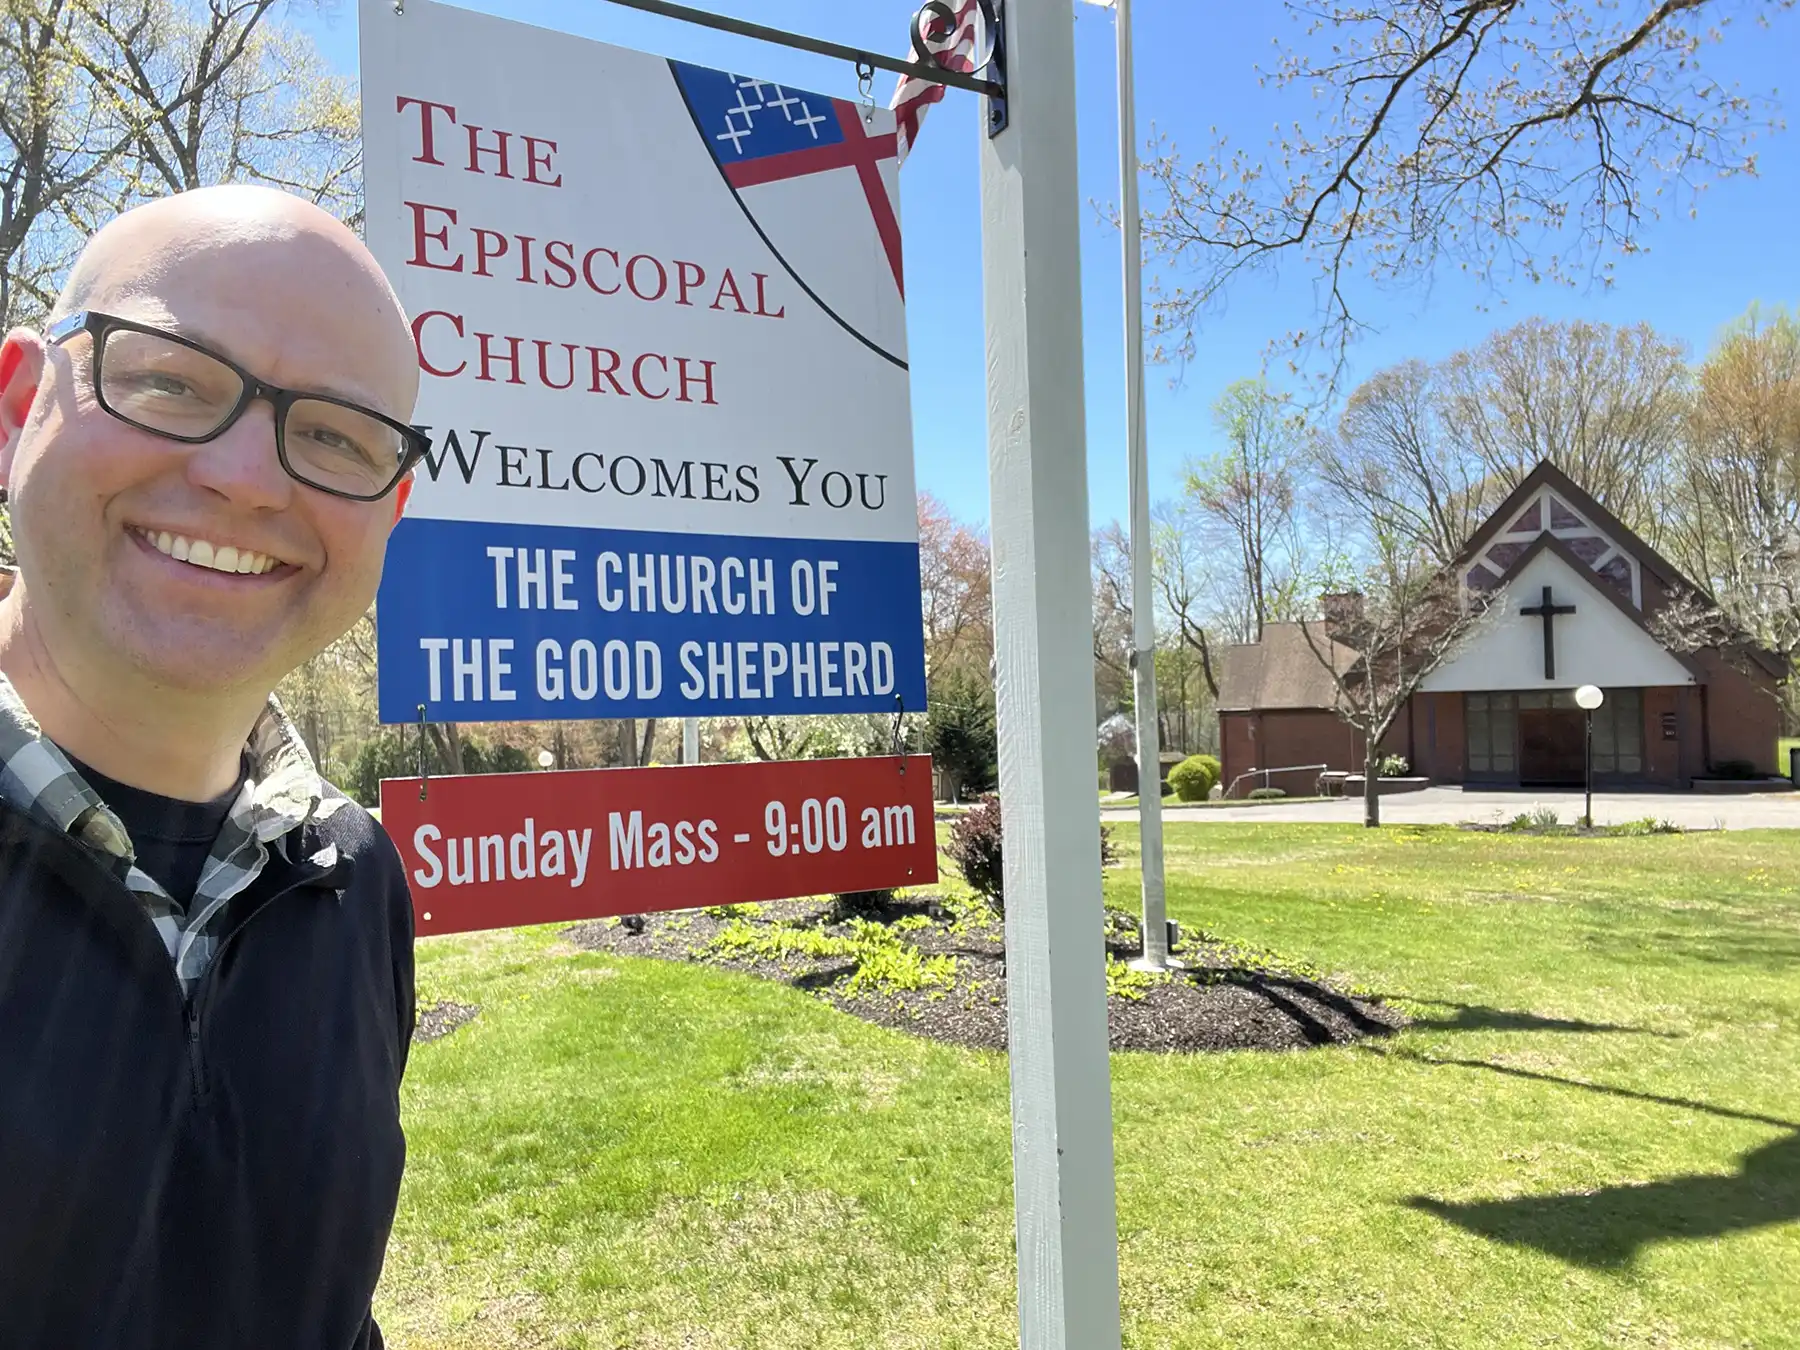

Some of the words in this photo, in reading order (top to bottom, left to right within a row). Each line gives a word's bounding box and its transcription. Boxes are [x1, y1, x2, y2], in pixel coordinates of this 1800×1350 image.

[396, 95, 562, 188] THE
[404, 201, 785, 319] EPISCOPAL
[411, 311, 719, 405] CHURCH
[410, 425, 760, 503] WELCOMES
[777, 456, 887, 510] YOU
[487, 546, 579, 611] THE
[597, 552, 776, 615] CHURCH
[791, 560, 838, 616] OF
[420, 638, 516, 701] THE
[536, 639, 662, 701] GOOD
[680, 641, 895, 700] SHEPHERD
[413, 818, 592, 888] Sunday
[609, 810, 719, 871] Mass
[764, 796, 846, 858] 9:00
[861, 803, 915, 849] am
